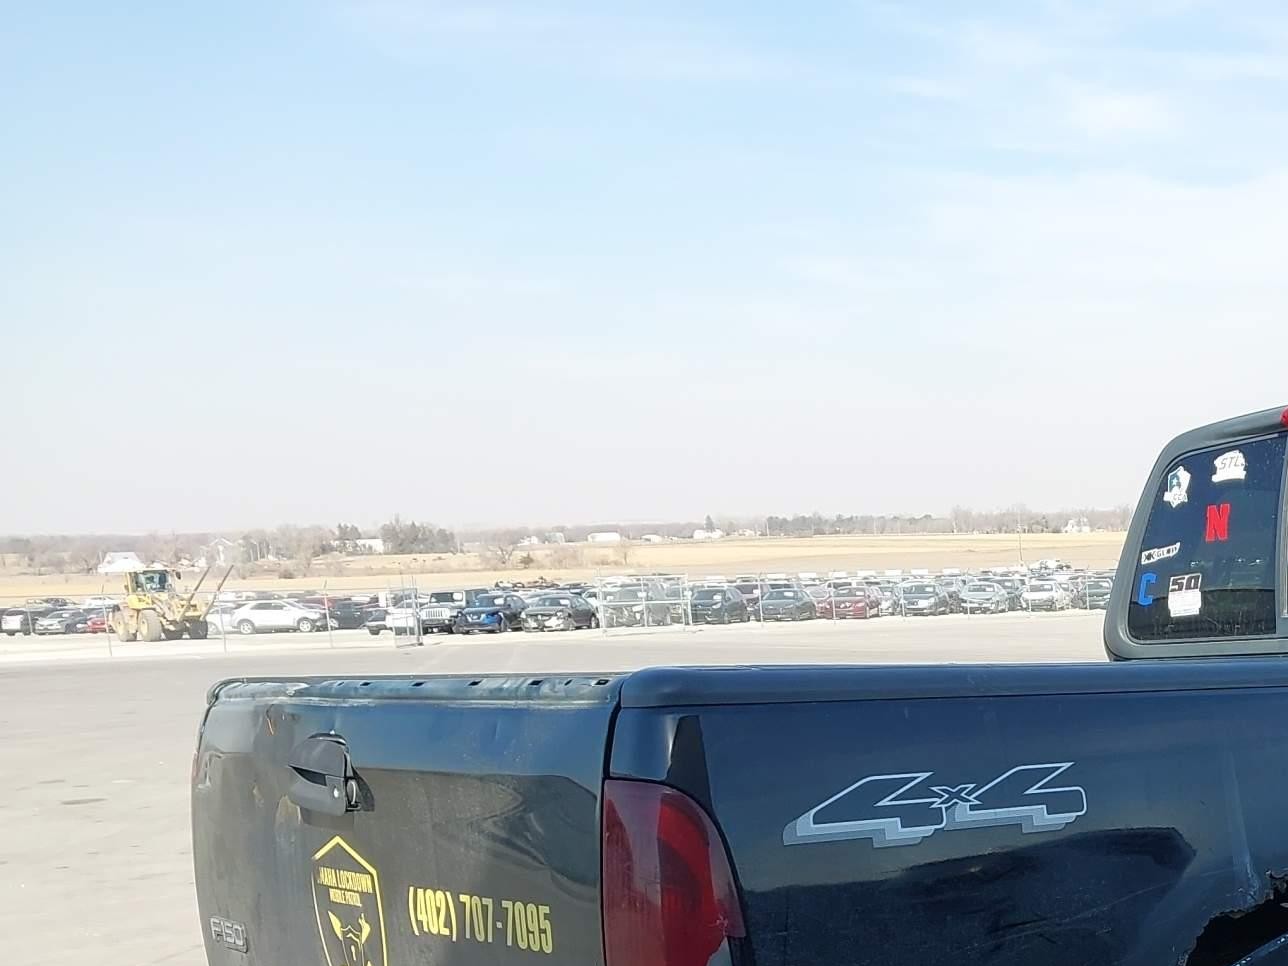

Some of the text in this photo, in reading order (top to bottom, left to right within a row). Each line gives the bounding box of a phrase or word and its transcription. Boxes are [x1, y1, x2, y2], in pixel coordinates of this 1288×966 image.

[1205, 503, 1230, 542] N
[335, 869, 374, 894] LOCKDOWN
[408, 886, 554, 955] (402) 707-7095
